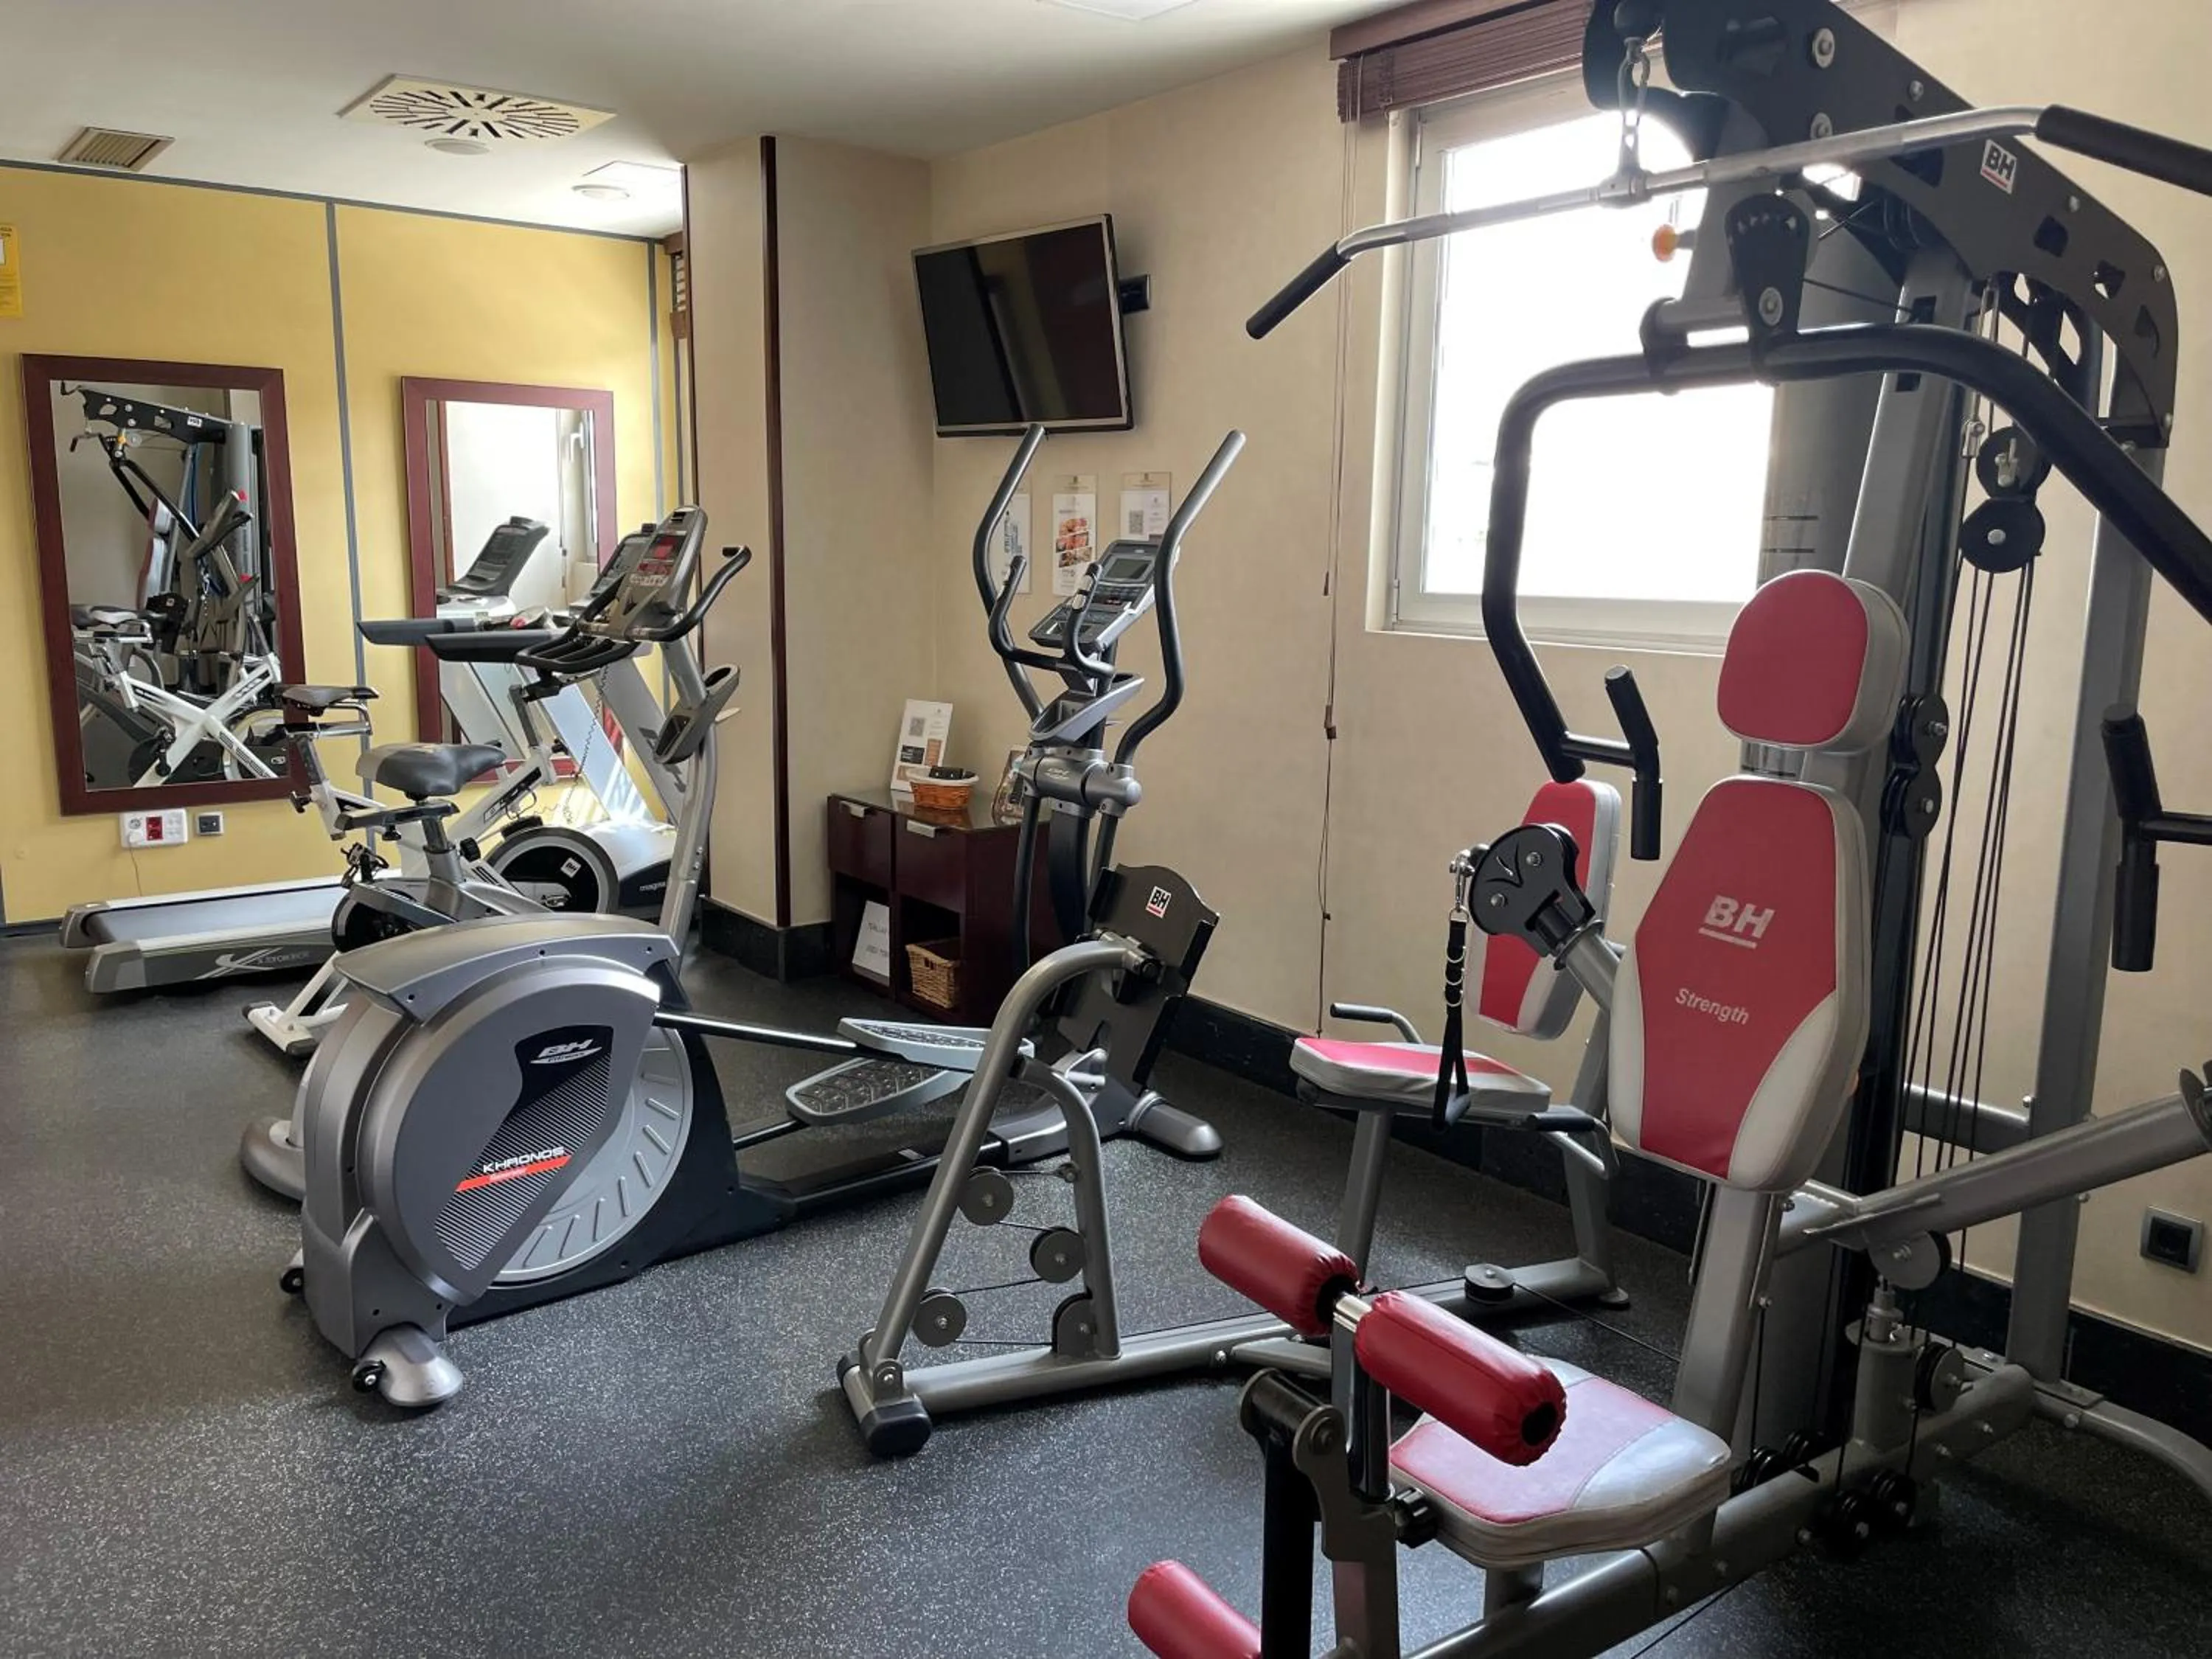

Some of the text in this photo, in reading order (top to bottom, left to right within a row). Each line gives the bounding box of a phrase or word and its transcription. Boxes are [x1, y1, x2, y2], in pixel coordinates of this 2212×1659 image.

[1985, 145, 2015, 180] BH
[1151, 891, 1170, 908] BH
[1705, 895, 1775, 938] BH
[1675, 988, 1750, 1025] Strength
[538, 1038, 594, 1057] BH
[484, 1146, 564, 1173] KHRONOS
